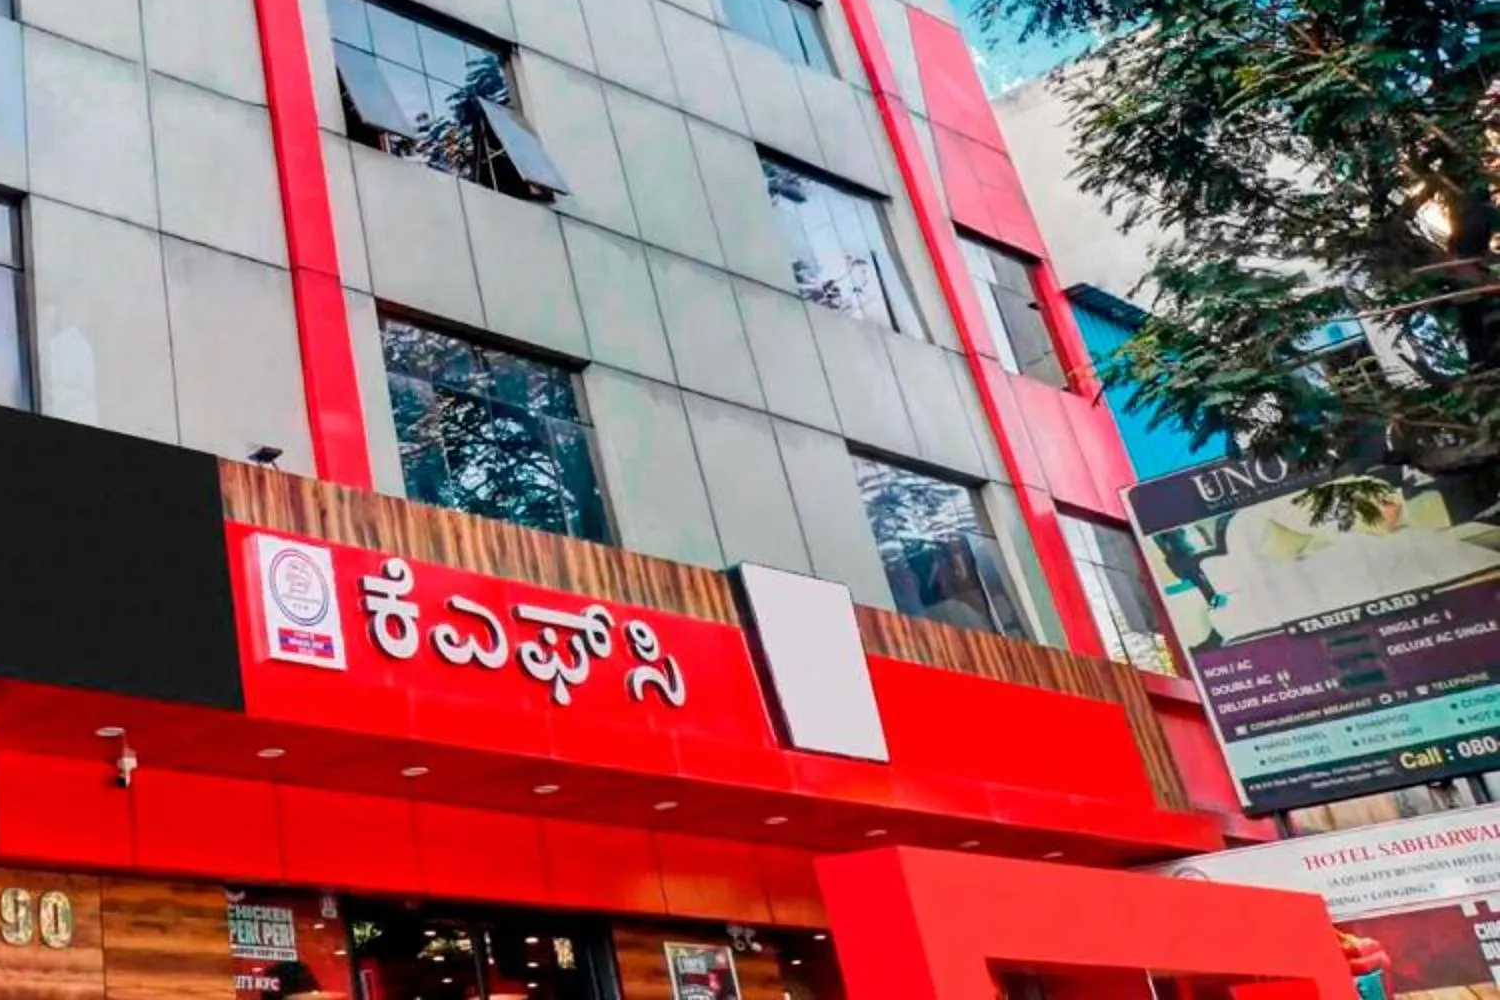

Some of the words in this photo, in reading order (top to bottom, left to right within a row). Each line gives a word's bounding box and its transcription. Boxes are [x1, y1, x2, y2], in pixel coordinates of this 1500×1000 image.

[1300, 607, 1362, 633] TARIFF
[1365, 593, 1419, 616] CARD
[1422, 612, 1441, 627] AC
[1400, 746, 1443, 770] Call
[1303, 846, 1375, 871] HOTEL
[0, 887, 73, 949] 90
